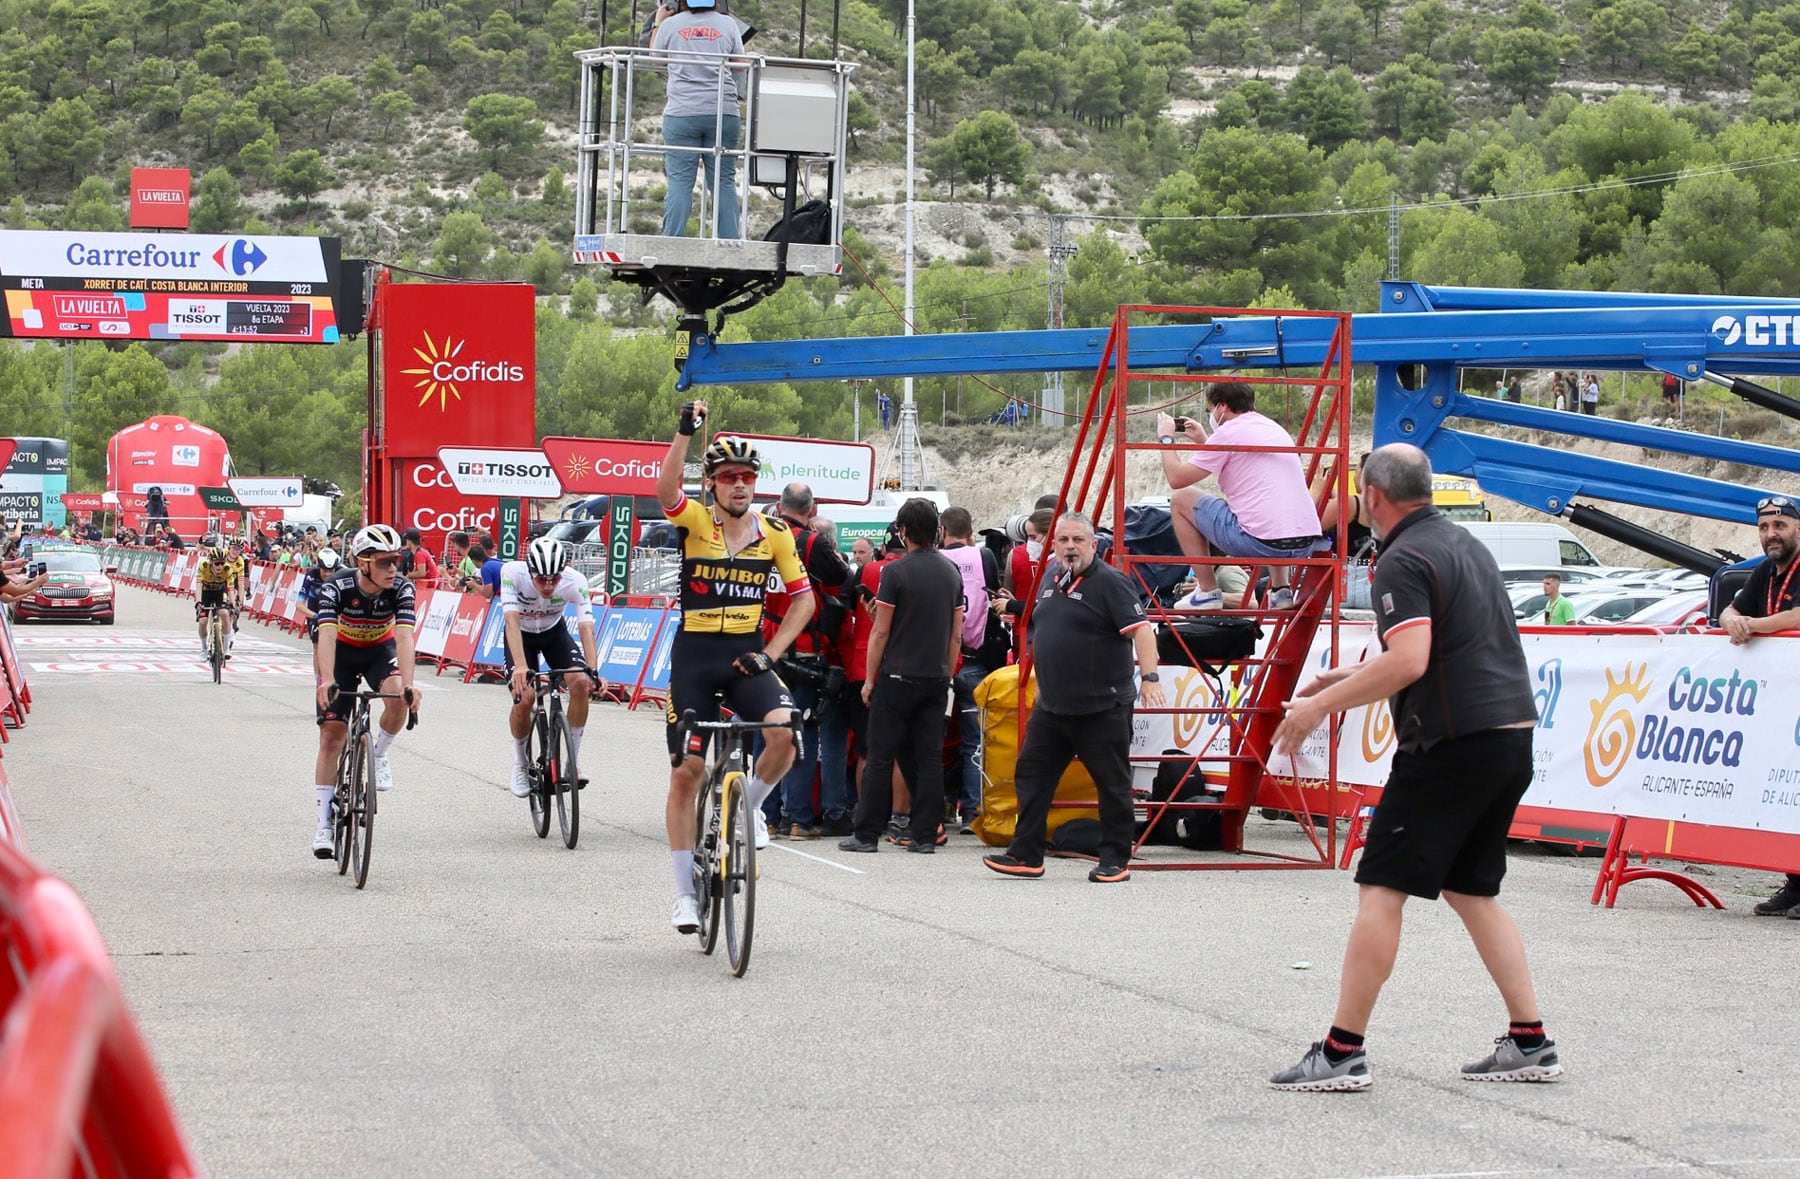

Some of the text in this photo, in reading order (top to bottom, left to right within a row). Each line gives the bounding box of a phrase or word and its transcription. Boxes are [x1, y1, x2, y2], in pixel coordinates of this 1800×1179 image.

[142, 191, 181, 202] LA VUELTA
[66, 243, 200, 268] Carrefour
[21, 278, 44, 289] META
[84, 279, 116, 290] XORRET
[117, 280, 128, 290] DE
[152, 281, 176, 291] COSTA
[178, 282, 209, 292] BLANCA
[210, 282, 248, 293] INTERIOR
[290, 284, 312, 295] 2023
[61, 299, 121, 315] LA VUELTA
[246, 304, 290, 314] VUELTA 2023
[173, 314, 221, 324] TISSOT
[262, 316, 284, 324] ETAPA
[1746, 315, 1800, 345] CT
[432, 360, 524, 383] Cofidis
[486, 463, 552, 478] TISSOT
[780, 462, 862, 482] plenitude
[237, 488, 278, 496] Carrefour
[226, 521, 236, 529] 50
[42, 544, 82, 552] Fertiberia
[692, 564, 766, 586] JUMBO
[715, 582, 762, 600] VISMA
[616, 617, 652, 642] LOTERÍAS
[1668, 666, 1759, 716] Costa
[1636, 714, 1744, 768] Blanca
[1762, 790, 1776, 804] DE
